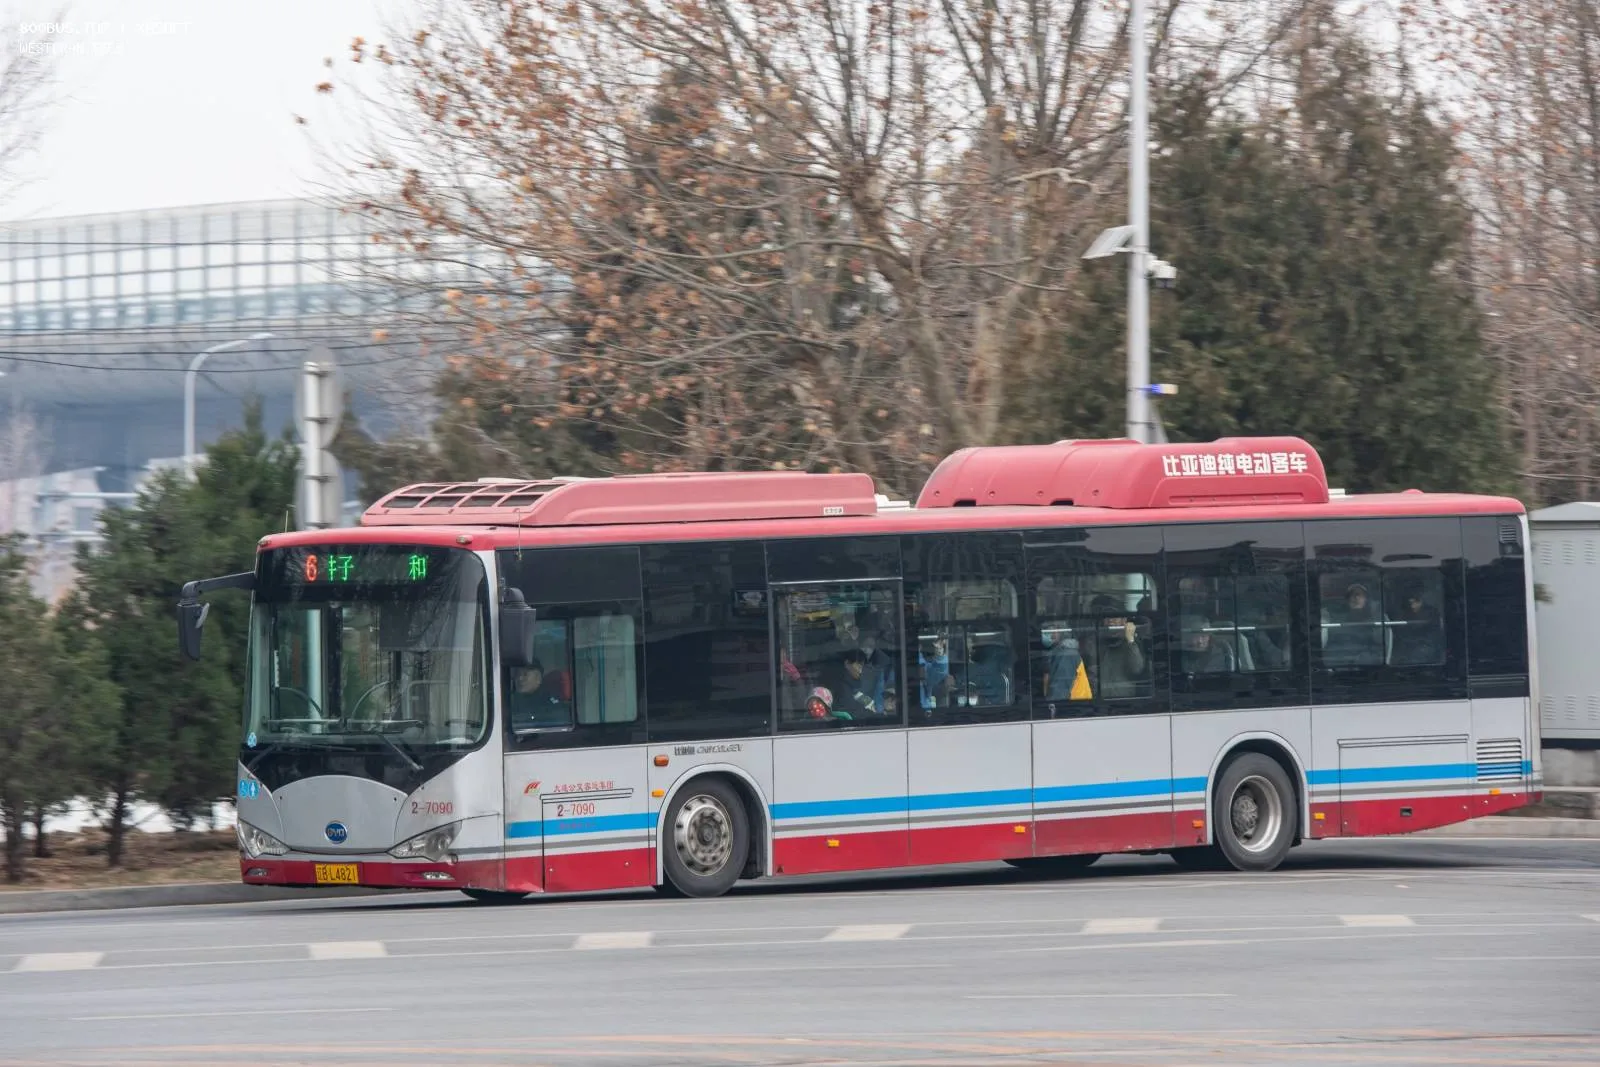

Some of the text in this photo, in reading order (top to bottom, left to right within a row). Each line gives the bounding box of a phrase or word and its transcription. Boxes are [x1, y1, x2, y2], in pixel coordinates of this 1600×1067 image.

[1162, 452, 1308, 476] 比亚迪纯电动客车
[306, 554, 318, 581] 6
[411, 801, 453, 814] 2-7090
[557, 803, 595, 817] 2-7090
